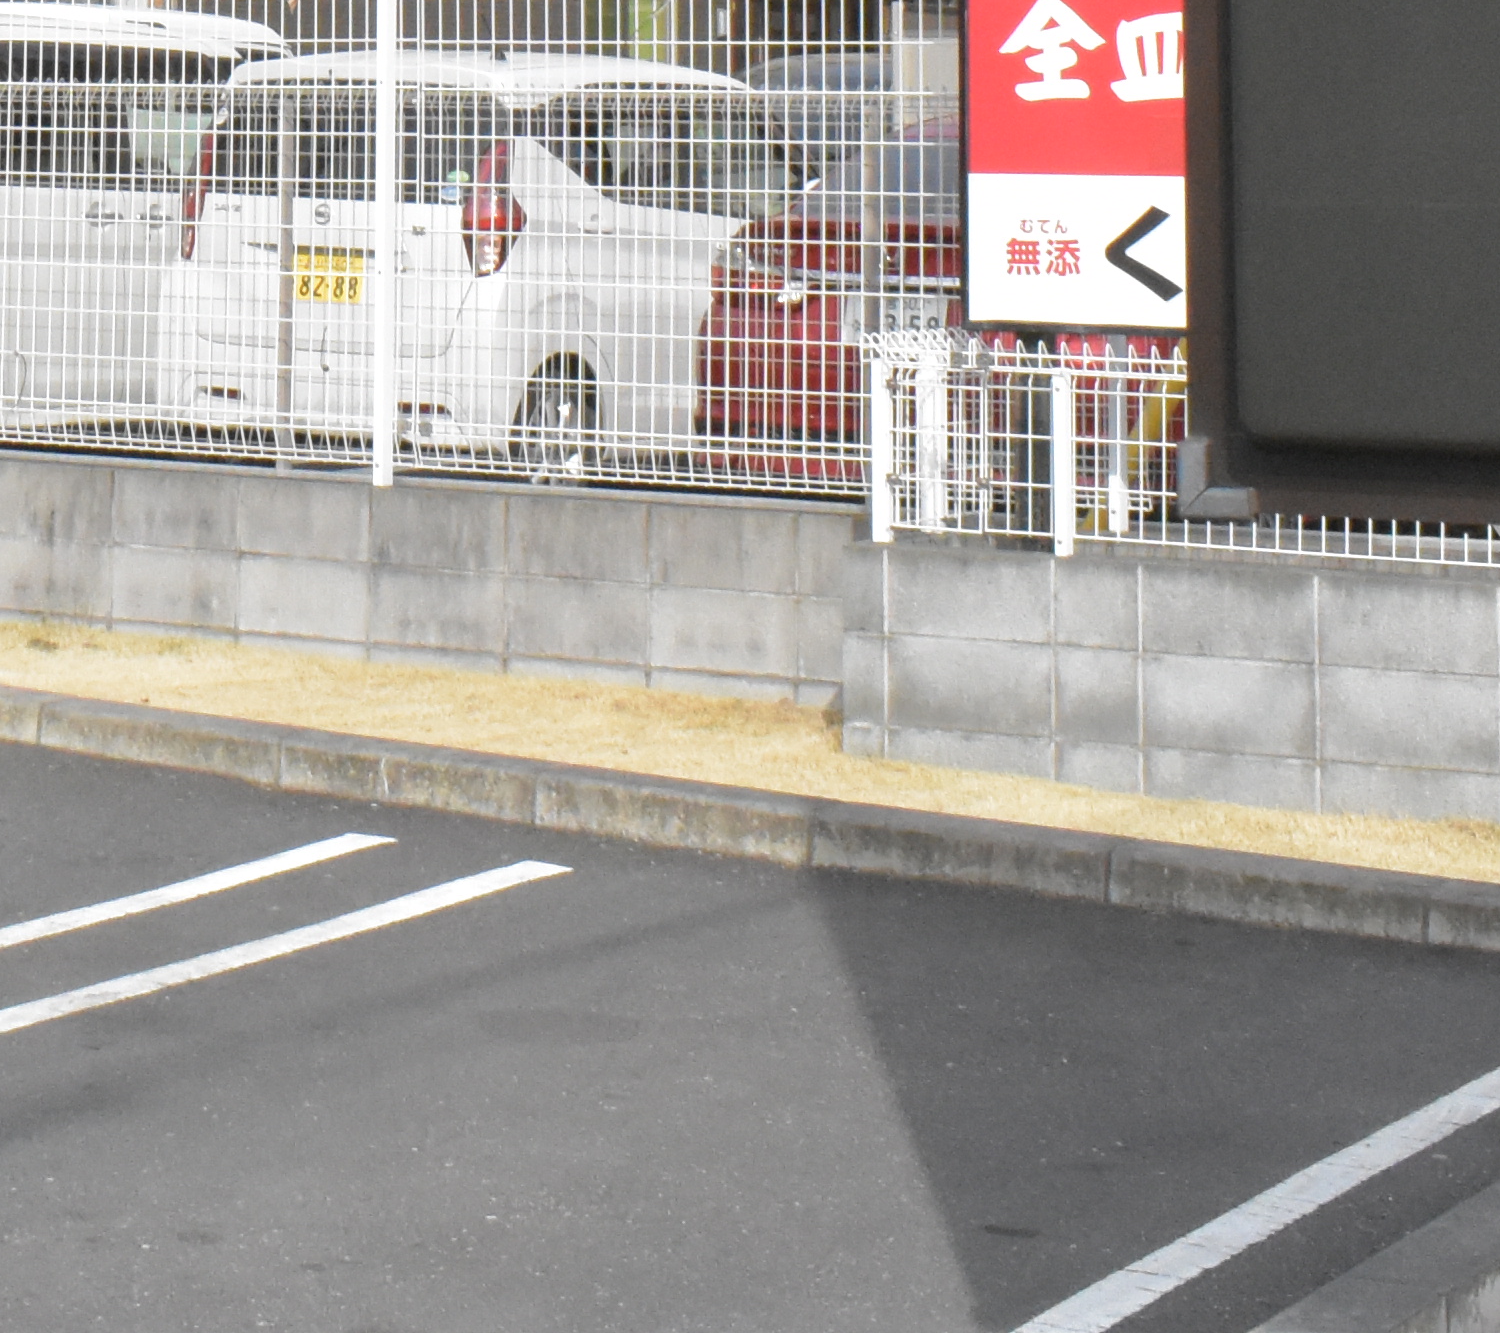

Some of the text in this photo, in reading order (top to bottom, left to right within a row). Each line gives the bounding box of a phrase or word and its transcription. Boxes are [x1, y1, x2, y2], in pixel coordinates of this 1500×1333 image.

[1005, 205, 1184, 302] 無添 く
[1019, 219, 1068, 234] むてん
